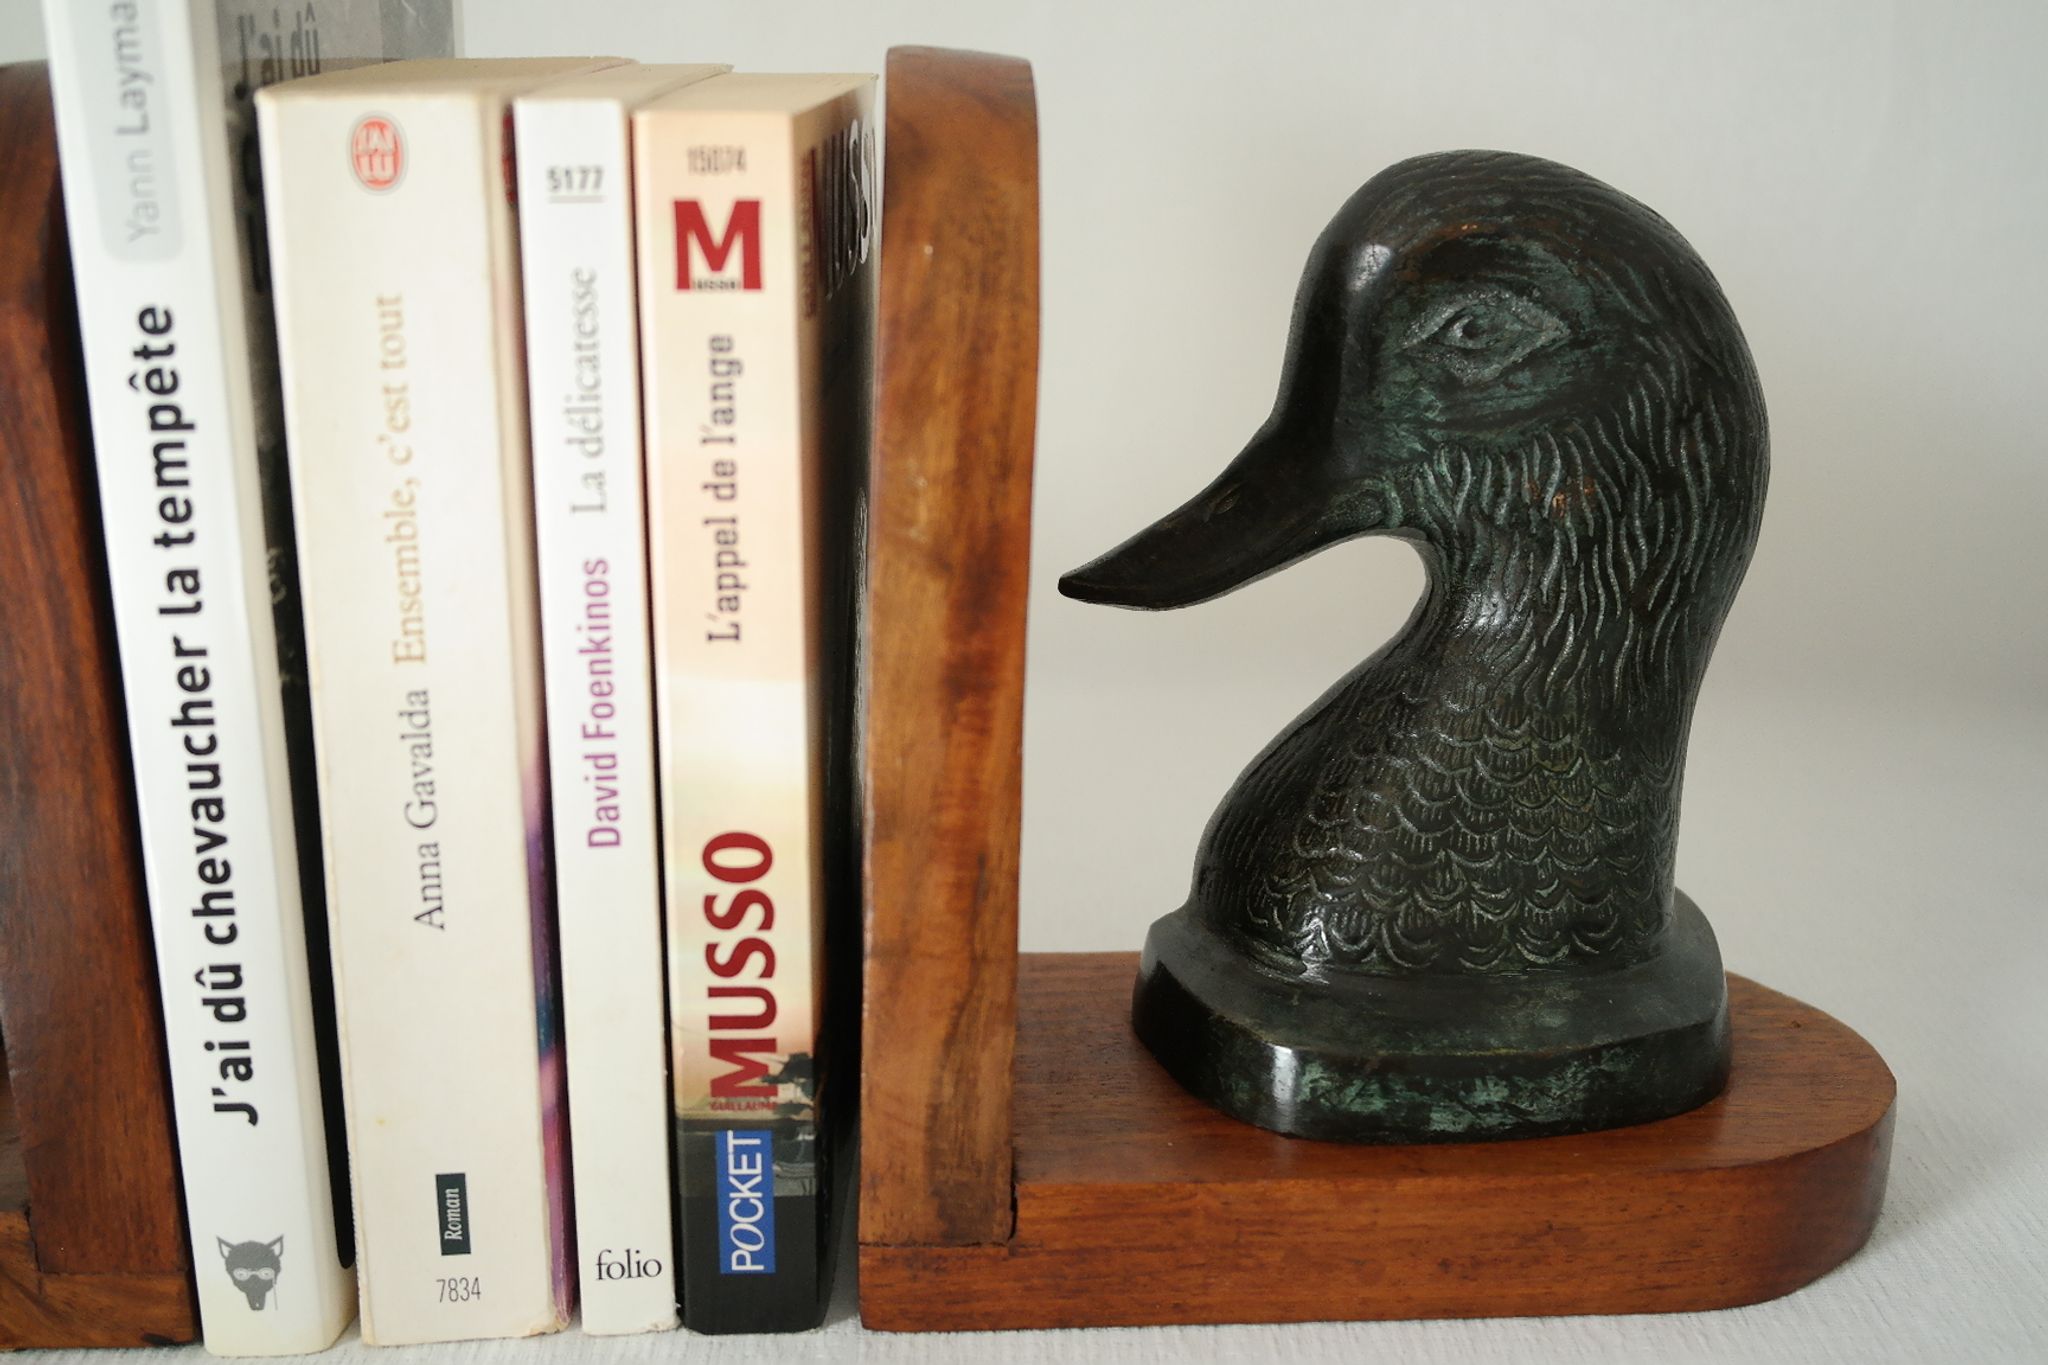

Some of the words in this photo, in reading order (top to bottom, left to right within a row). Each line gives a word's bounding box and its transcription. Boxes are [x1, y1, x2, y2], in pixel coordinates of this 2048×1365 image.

[109, 0, 154, 136] Layma
[126, 149, 160, 243] Yann
[547, 165, 604, 193] 5177
[376, 294, 407, 370] tout
[564, 267, 606, 460] délicatesse
[126, 305, 195, 549] tempête
[377, 383, 413, 465] c'est
[701, 333, 743, 446] l'ange
[571, 470, 607, 514] La
[703, 458, 738, 503] de
[159, 567, 203, 615] la
[383, 477, 426, 665] Ensemble,
[703, 515, 748, 643] L'appel
[576, 558, 616, 741] Foenkinos
[170, 635, 238, 946] chevaucher
[401, 688, 439, 829] Gavalda
[584, 752, 622, 849] David
[414, 841, 445, 931] Anna
[195, 963, 247, 1024] dû
[702, 831, 779, 1099] MUSSO
[204, 1040, 259, 1126] J'ai
[443, 1187, 463, 1241] Roman
[726, 1129, 766, 1272] POCKET
[436, 1277, 482, 1303] 7834
[596, 1249, 662, 1281] folio
